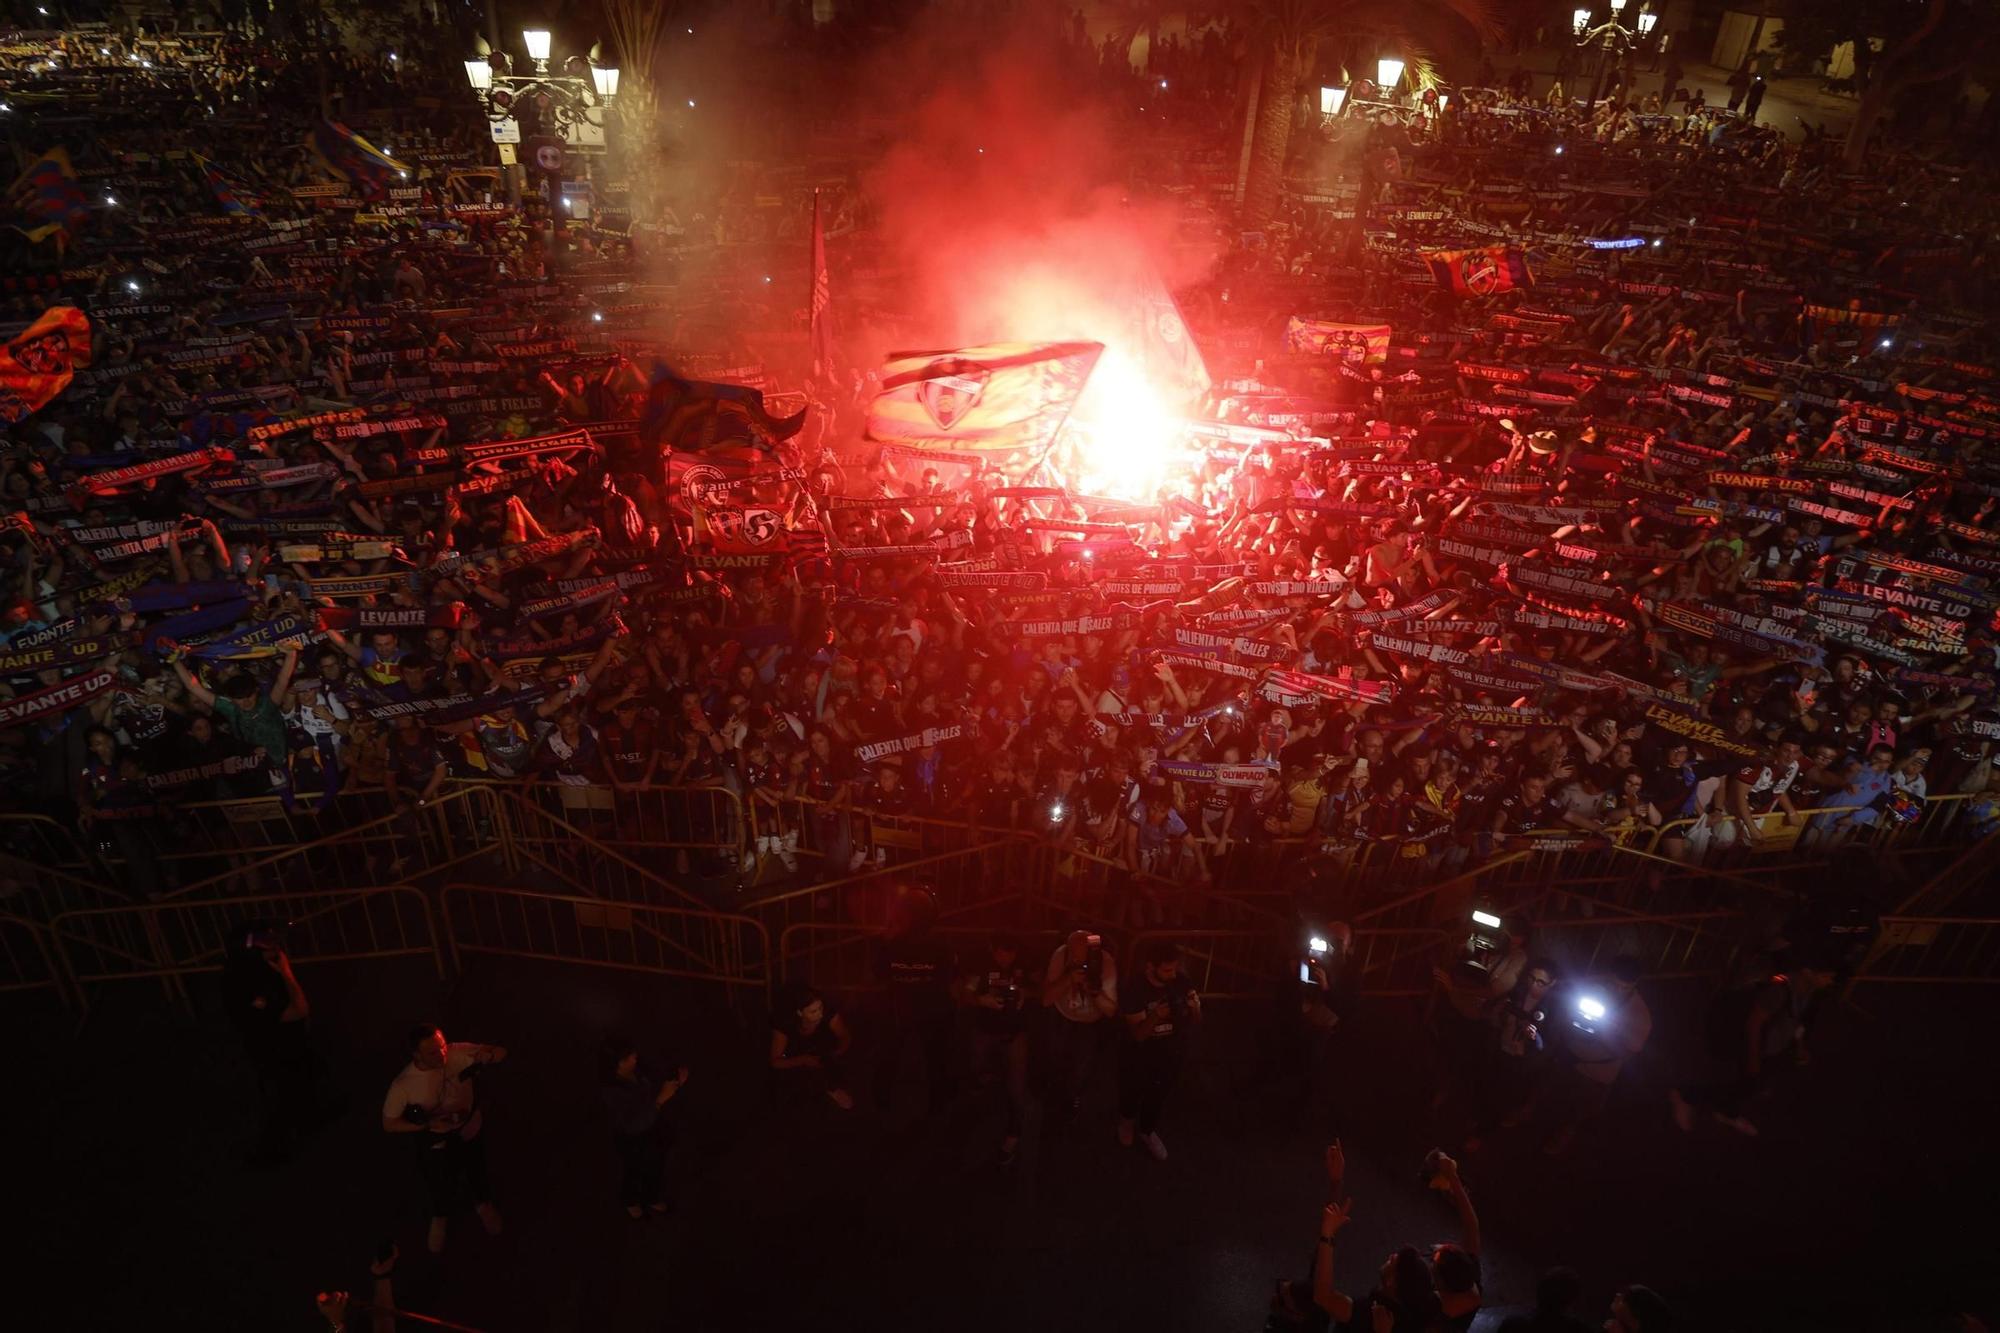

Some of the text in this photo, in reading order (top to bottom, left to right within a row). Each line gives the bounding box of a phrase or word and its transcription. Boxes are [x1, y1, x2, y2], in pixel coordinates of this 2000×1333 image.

[455, 203, 488, 211] LEVANTE
[1619, 282, 1656, 295] LEVANTE
[90, 304, 171, 318] LEVANTE UD
[326, 318, 373, 329] LEVANTE
[1458, 366, 1498, 379] LEVANTE
[448, 397, 543, 415] SIEMPRE FIELES
[530, 437, 585, 449] LEVANTE
[1356, 463, 1414, 474] LEVANTE
[1682, 455, 1701, 466] UD
[208, 478, 242, 490] LEVANTE
[458, 469, 531, 493] LEVANTE
[1709, 473, 1770, 489] LEVANTE
[1745, 509, 1783, 523] ANA
[72, 524, 138, 542] CALIENTA QUE
[95, 537, 162, 561] CALIENTA QUE
[1439, 539, 1474, 558] CALIENTA
[1474, 547, 1490, 562] QUE
[693, 554, 770, 569] LEVANTE
[312, 579, 384, 593] LEVANTE
[939, 573, 1010, 588] LEVANTE
[1131, 582, 1143, 595] DE
[521, 601, 554, 617] LEVANTE
[1818, 600, 1850, 615] LEVANTE
[1864, 584, 1971, 618] LEVANTE UD
[360, 609, 426, 623] LEVANTE
[274, 617, 296, 635] UD
[1022, 616, 1113, 635] CALIENTA QUE SALES
[1405, 620, 1499, 636] LEVANTE UD
[1742, 615, 1761, 630] QUE
[1766, 620, 1798, 640] SALES
[1815, 620, 1851, 639] SOY
[72, 642, 99, 656] UD
[1175, 629, 1215, 648] CALIENTA
[1242, 641, 1271, 658] SALES
[1372, 633, 1469, 664] CALIENTA QUE SALES
[1897, 638, 1969, 655] GRANOTA
[1160, 652, 1224, 672] CALIENTA QUE
[1474, 673, 1494, 685] VENT
[0, 672, 113, 723] EVANTE UD
[1264, 690, 1282, 703] QUE
[369, 701, 413, 719] CALIENTA
[1646, 704, 1727, 739] LEVANTE
[858, 724, 962, 762] CALIENTA QUE SALES
[147, 763, 223, 789] CALIENTA QUE
[1199, 769, 1216, 779] U.D.
